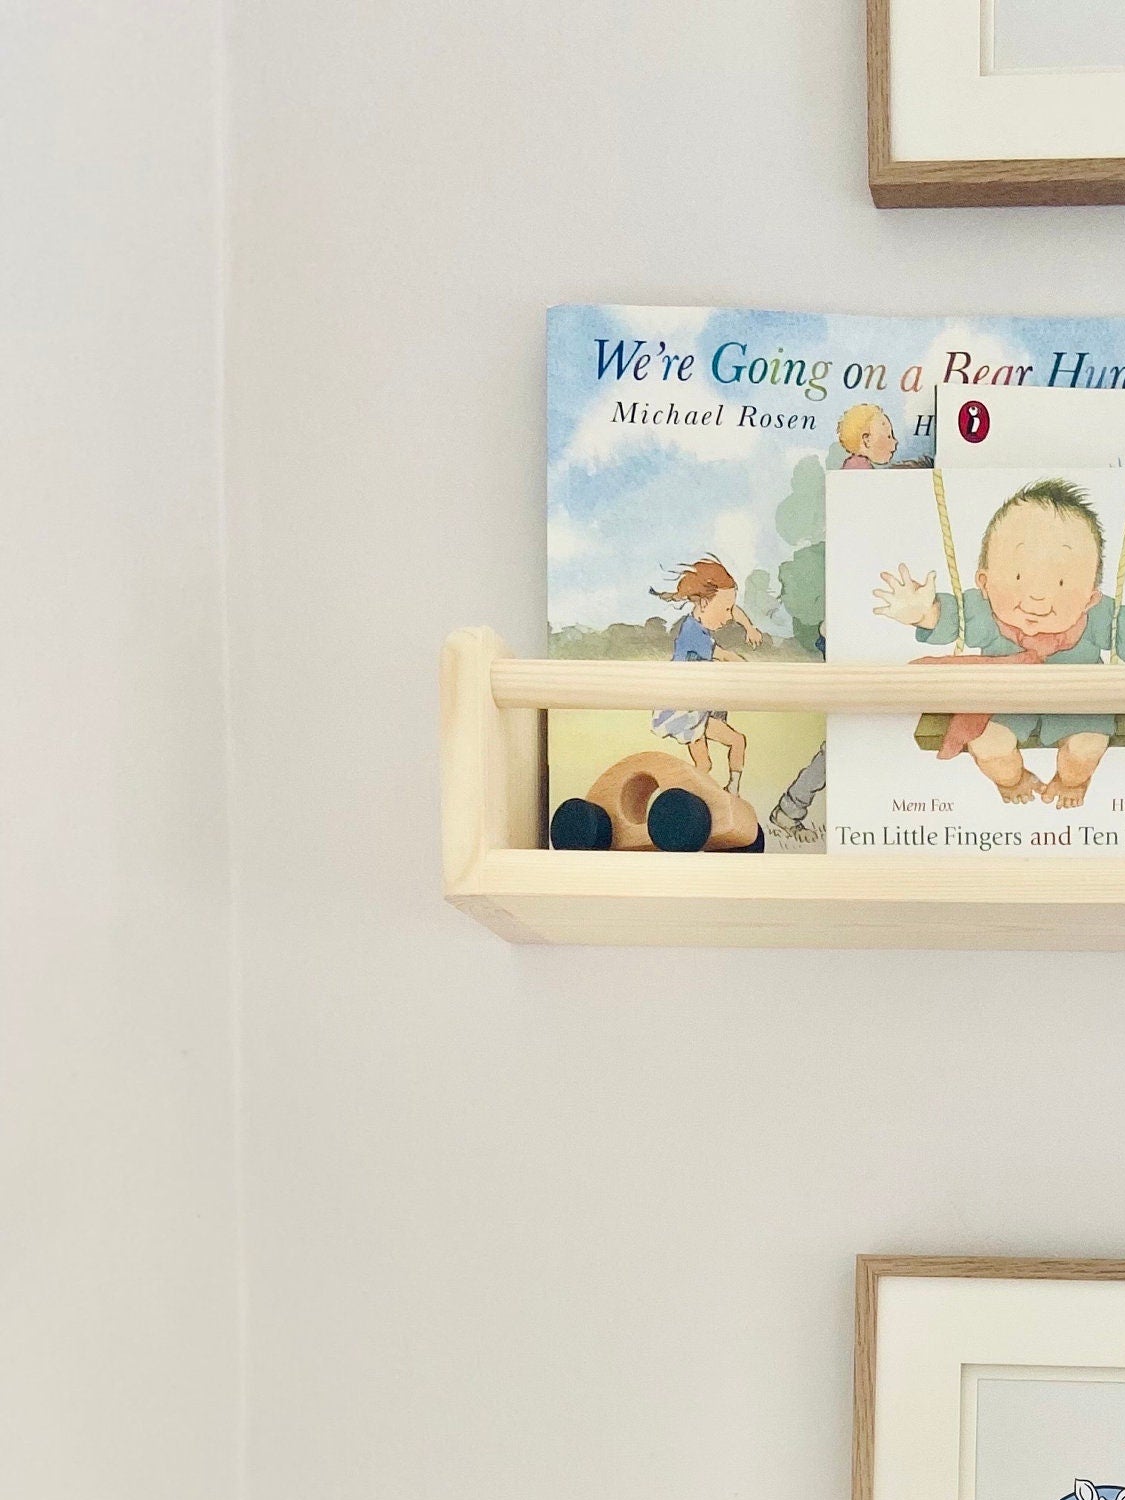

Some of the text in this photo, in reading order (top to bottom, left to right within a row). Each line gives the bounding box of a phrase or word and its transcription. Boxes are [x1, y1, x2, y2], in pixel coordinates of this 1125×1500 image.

[593, 338, 695, 382] We're
[711, 341, 833, 402] Going
[843, 362, 886, 391] on
[900, 365, 923, 393] a
[943, 351, 1034, 387] Bear
[611, 401, 816, 430] Michael Rosen
[892, 798, 953, 812] Mem Fox
[835, 826, 875, 846] Ten
[883, 825, 938, 846] Little
[944, 825, 1022, 852] Fingers
[1030, 825, 1071, 846] and
[1078, 826, 1118, 846] Ten
